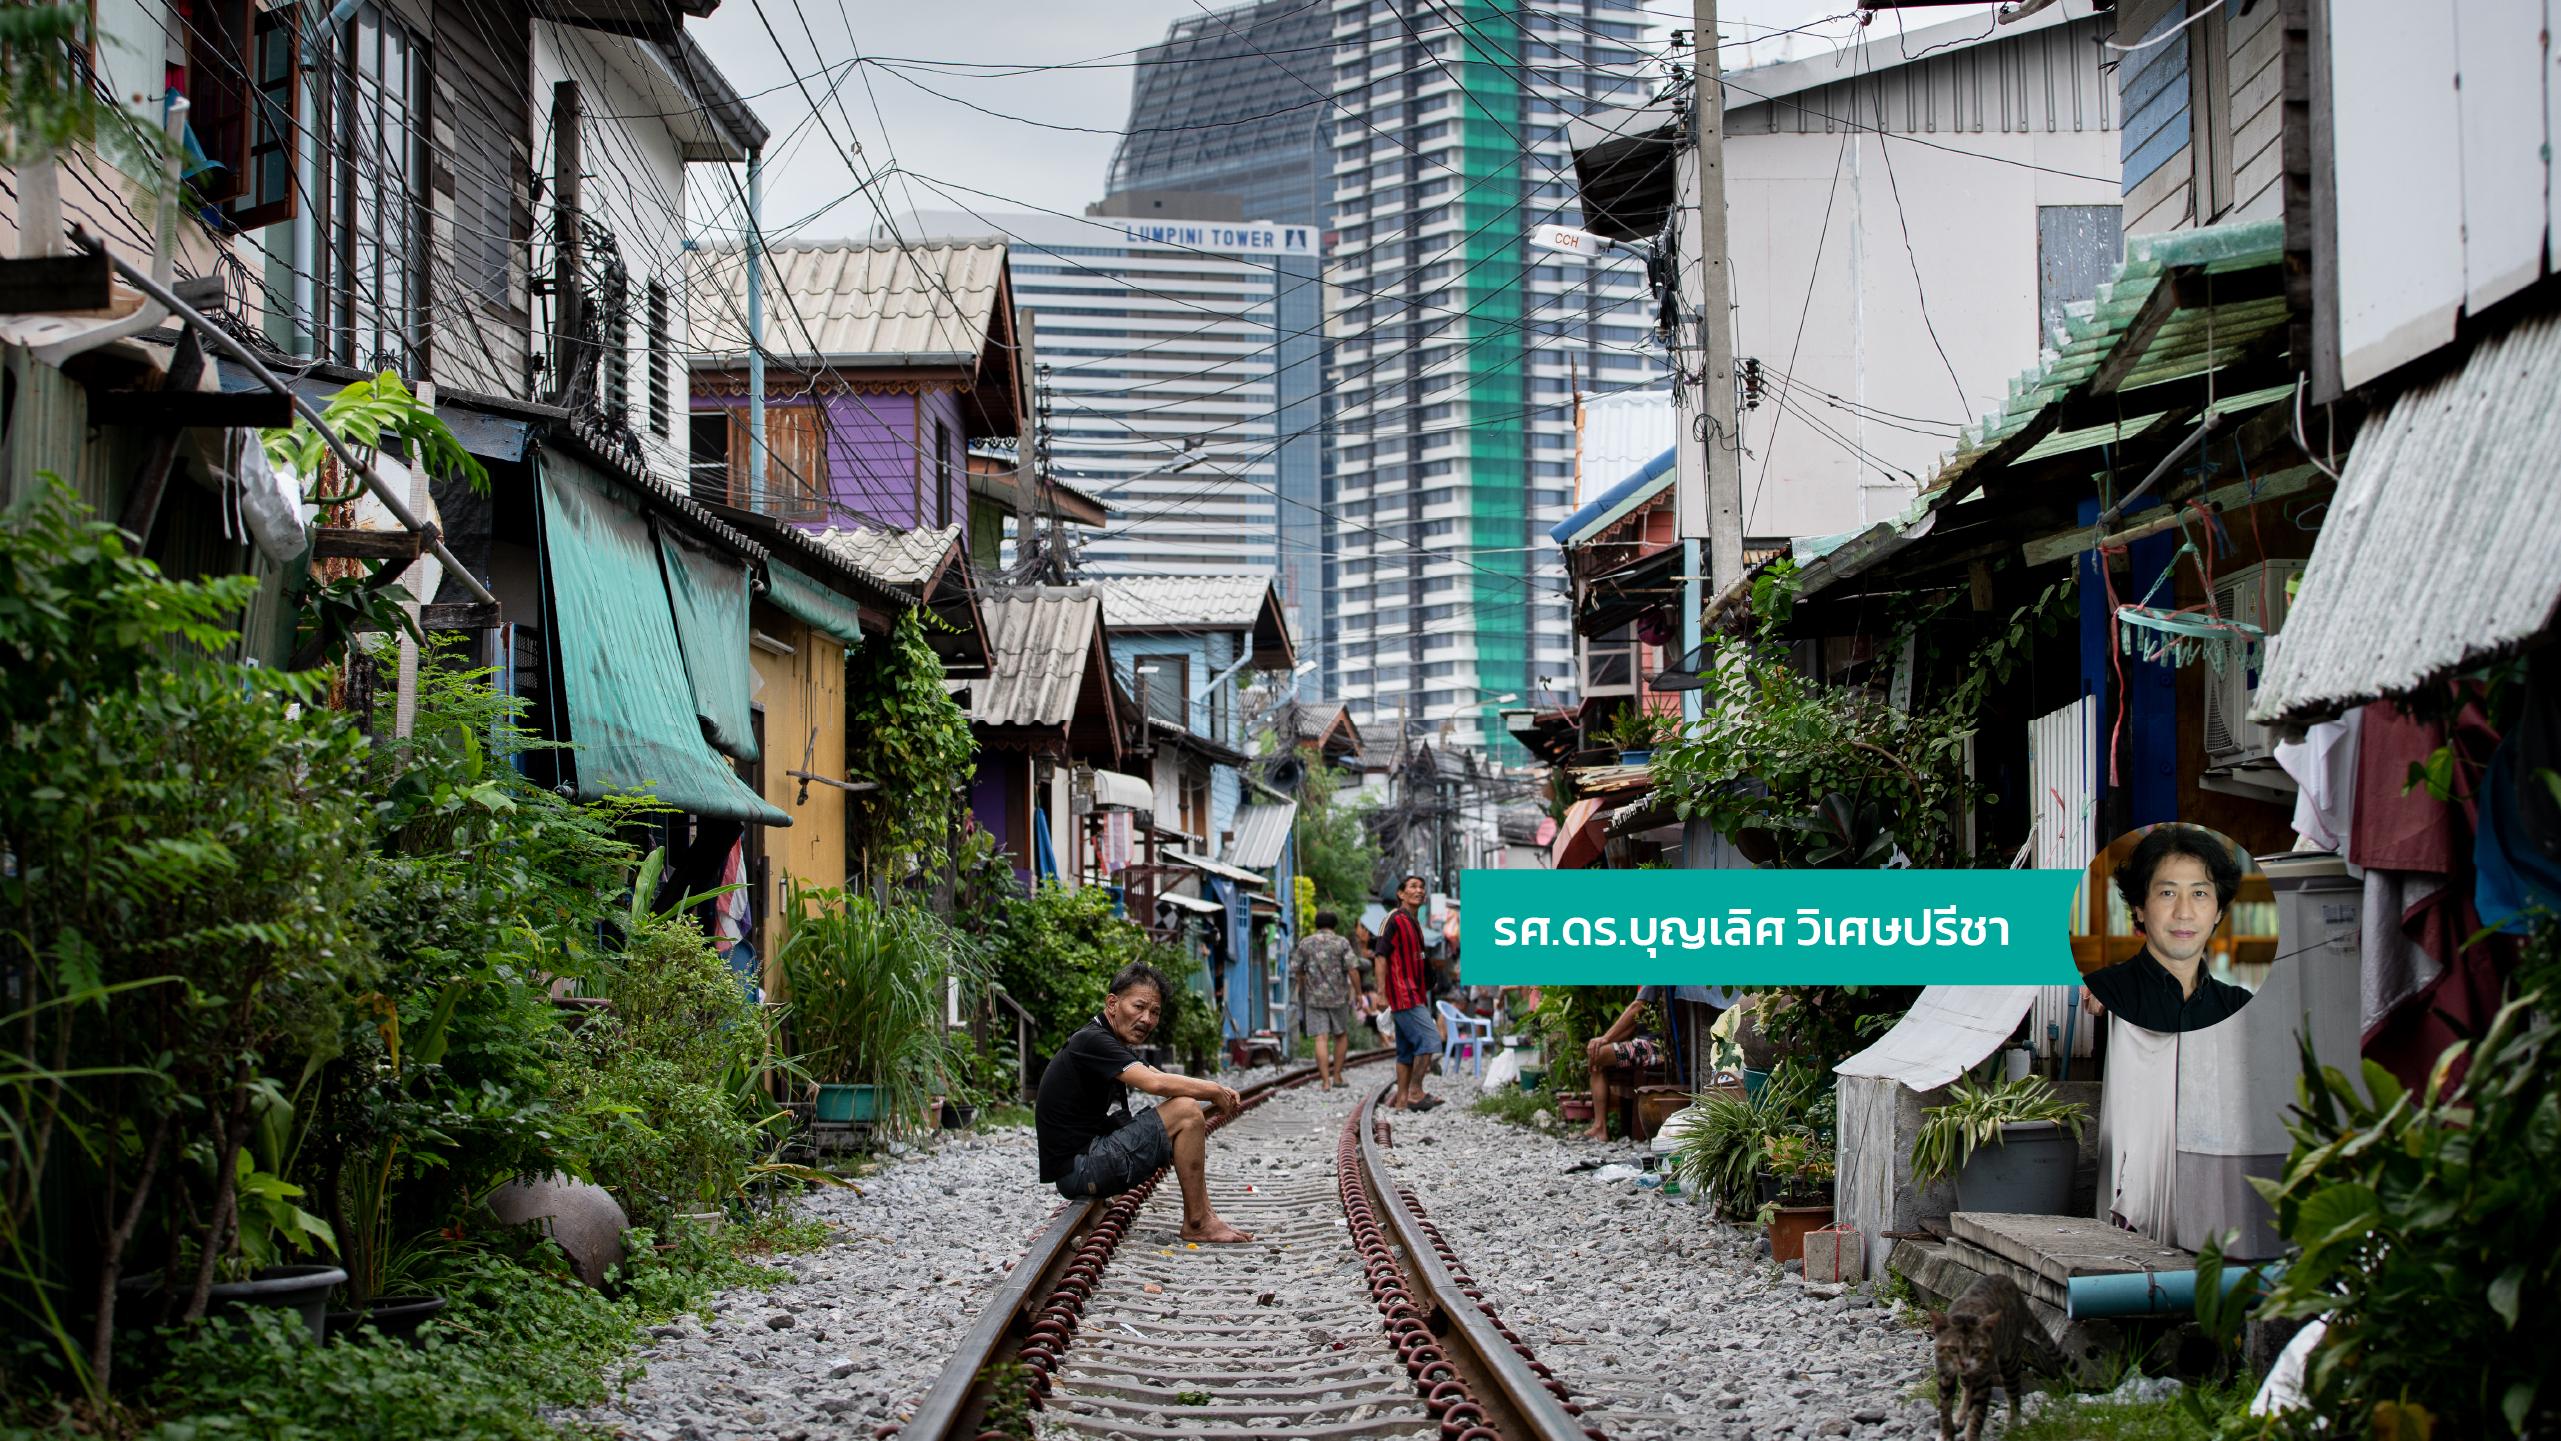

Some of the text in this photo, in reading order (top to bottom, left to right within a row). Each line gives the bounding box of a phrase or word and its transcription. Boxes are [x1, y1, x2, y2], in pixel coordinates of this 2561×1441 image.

[1127, 226, 1274, 248] LUMPINI TOWER
[1555, 233, 1579, 248] CCH
